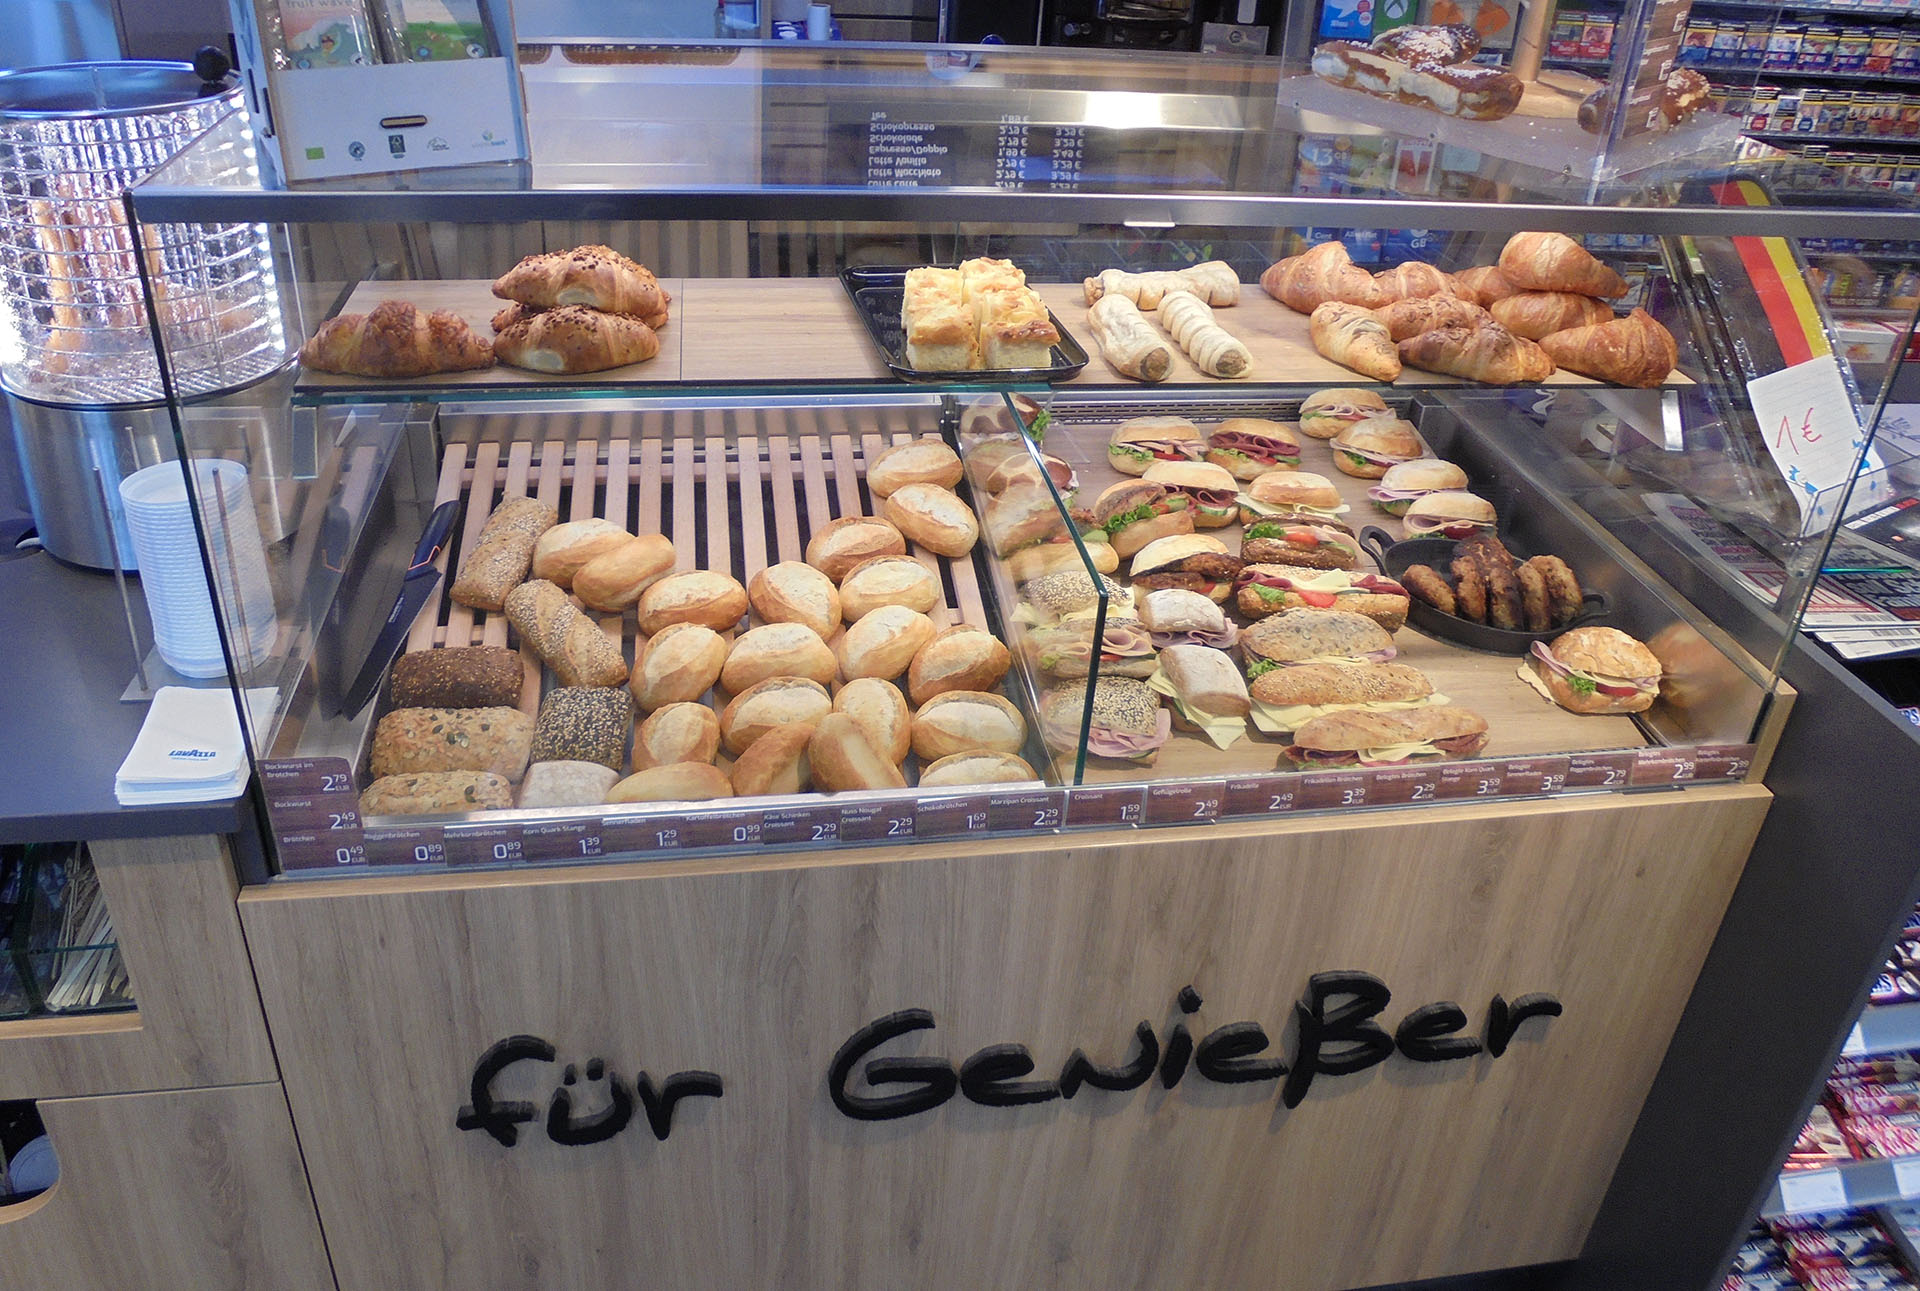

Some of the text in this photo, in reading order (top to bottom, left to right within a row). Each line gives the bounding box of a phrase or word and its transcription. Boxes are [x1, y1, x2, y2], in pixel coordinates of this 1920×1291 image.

[168, 748, 217, 758] LAVAZZA
[264, 762, 302, 770] Bockwurst
[274, 800, 312, 808] Bockwurst
[456, 1034, 723, 1148] für
